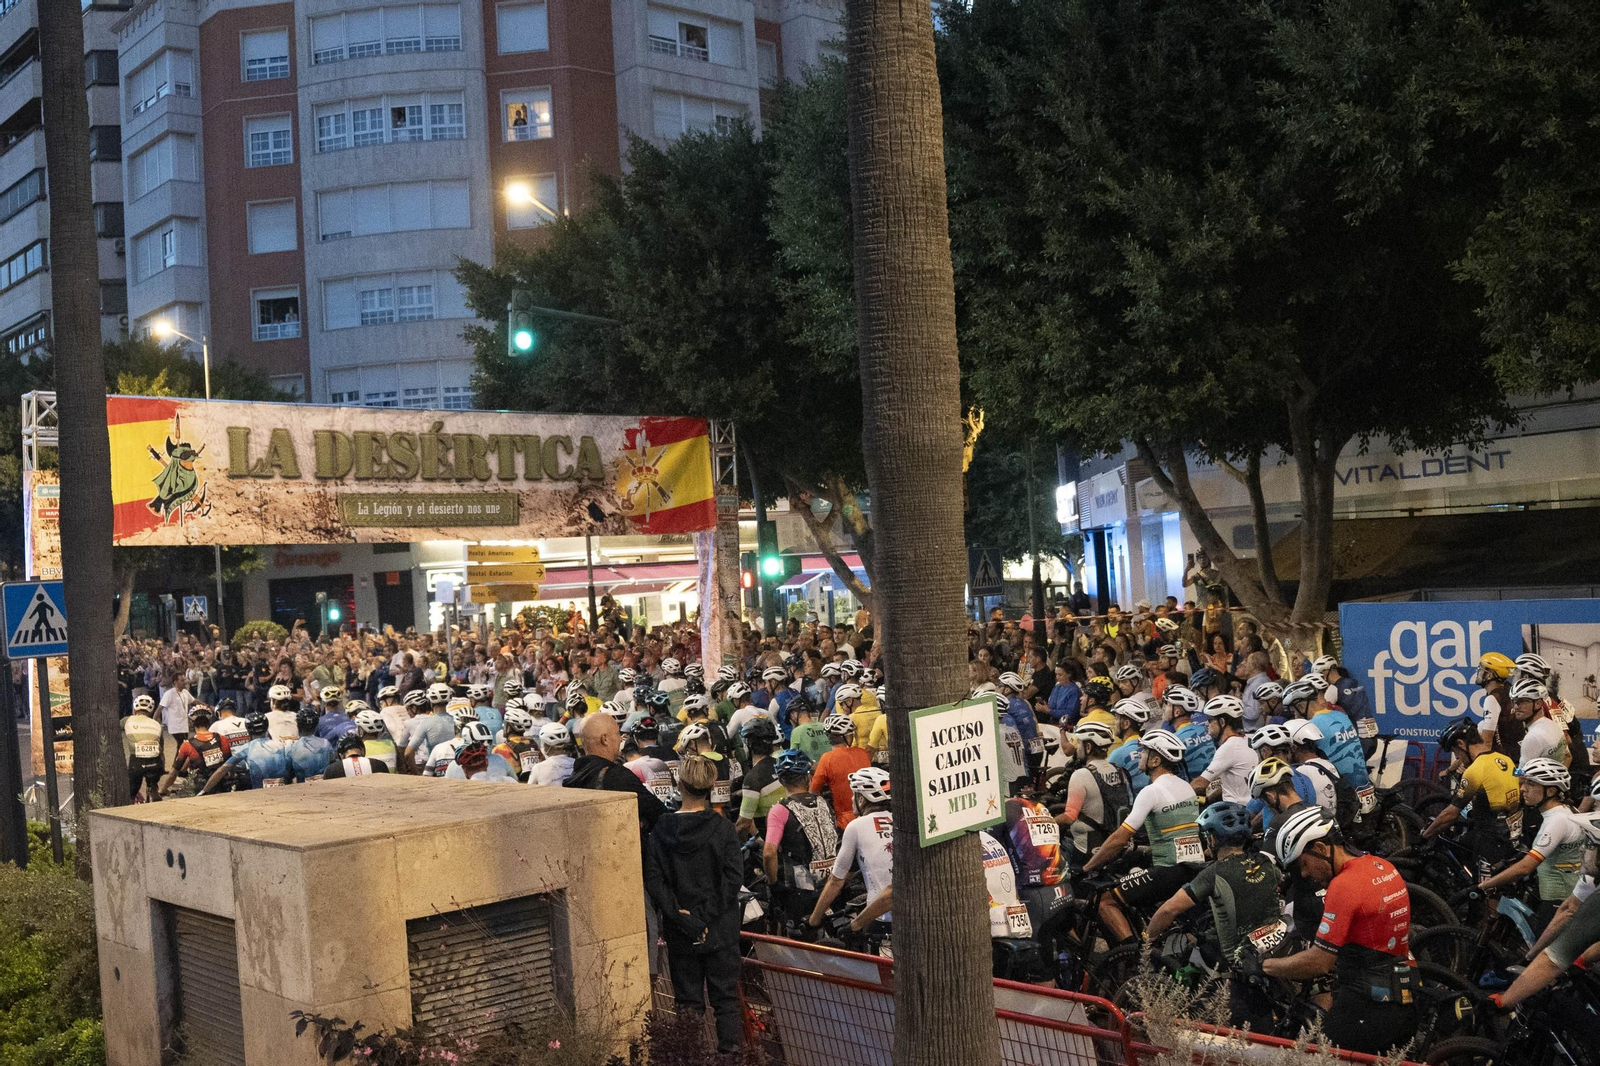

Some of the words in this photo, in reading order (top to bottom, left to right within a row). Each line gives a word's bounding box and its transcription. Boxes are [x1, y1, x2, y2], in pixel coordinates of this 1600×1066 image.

[226, 426, 302, 479] LA
[312, 420, 605, 481] DESÉRTICA
[1335, 451, 1511, 486] VITALDENT
[358, 503, 369, 515] La
[373, 502, 403, 518] Legión
[407, 505, 413, 517] y
[417, 503, 425, 515] el
[429, 503, 464, 515] desierto
[468, 504, 482, 515] nos
[486, 504, 501, 514] une
[41, 567, 63, 576] BBV
[1389, 619, 1493, 685] gar
[930, 720, 984, 748] ACCESO
[1393, 727, 1443, 738] CONSTRUC
[935, 743, 982, 771] CAJÓN
[928, 768, 981, 797] SALIDA
[985, 765, 991, 782] 1
[654, 786, 671, 796] 6323
[948, 791, 978, 815] MTB
[1161, 801, 1194, 813] GUARDIA
[1036, 823, 1057, 835] 7261
[1184, 844, 1200, 856] 7870
[1119, 868, 1149, 883] GUARDIA
[1121, 874, 1154, 891] CIVIL
[1261, 929, 1285, 950] 5546
